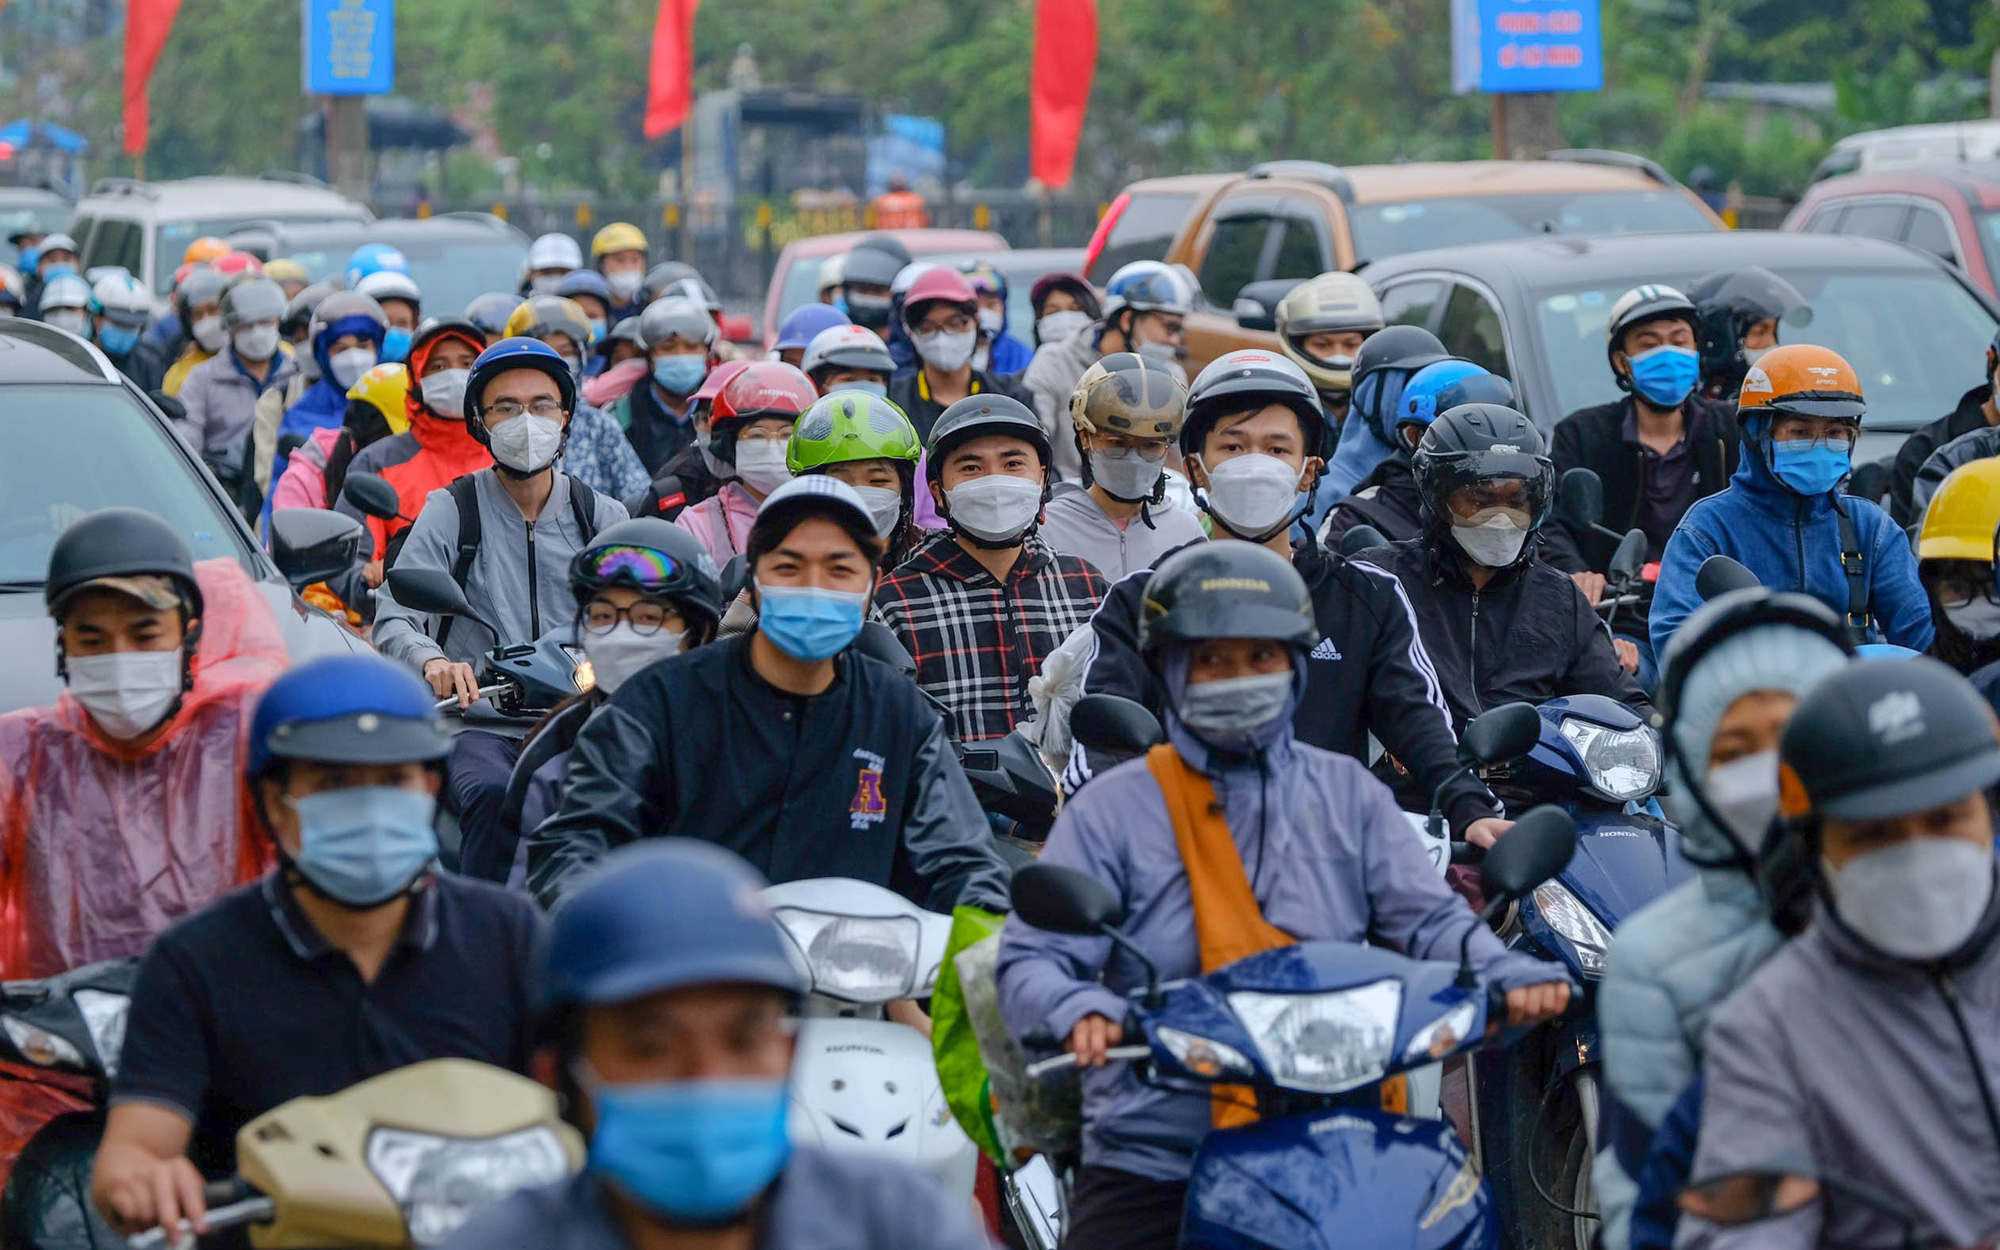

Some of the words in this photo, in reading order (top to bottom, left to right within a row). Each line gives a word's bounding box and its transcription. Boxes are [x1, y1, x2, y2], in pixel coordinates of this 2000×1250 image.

[759, 389, 799, 399] HONDA
[1201, 578, 1270, 592] HONDA
[1310, 650, 1342, 660] adidas
[849, 768, 887, 813] A
[825, 1045, 885, 1056] HONDA
